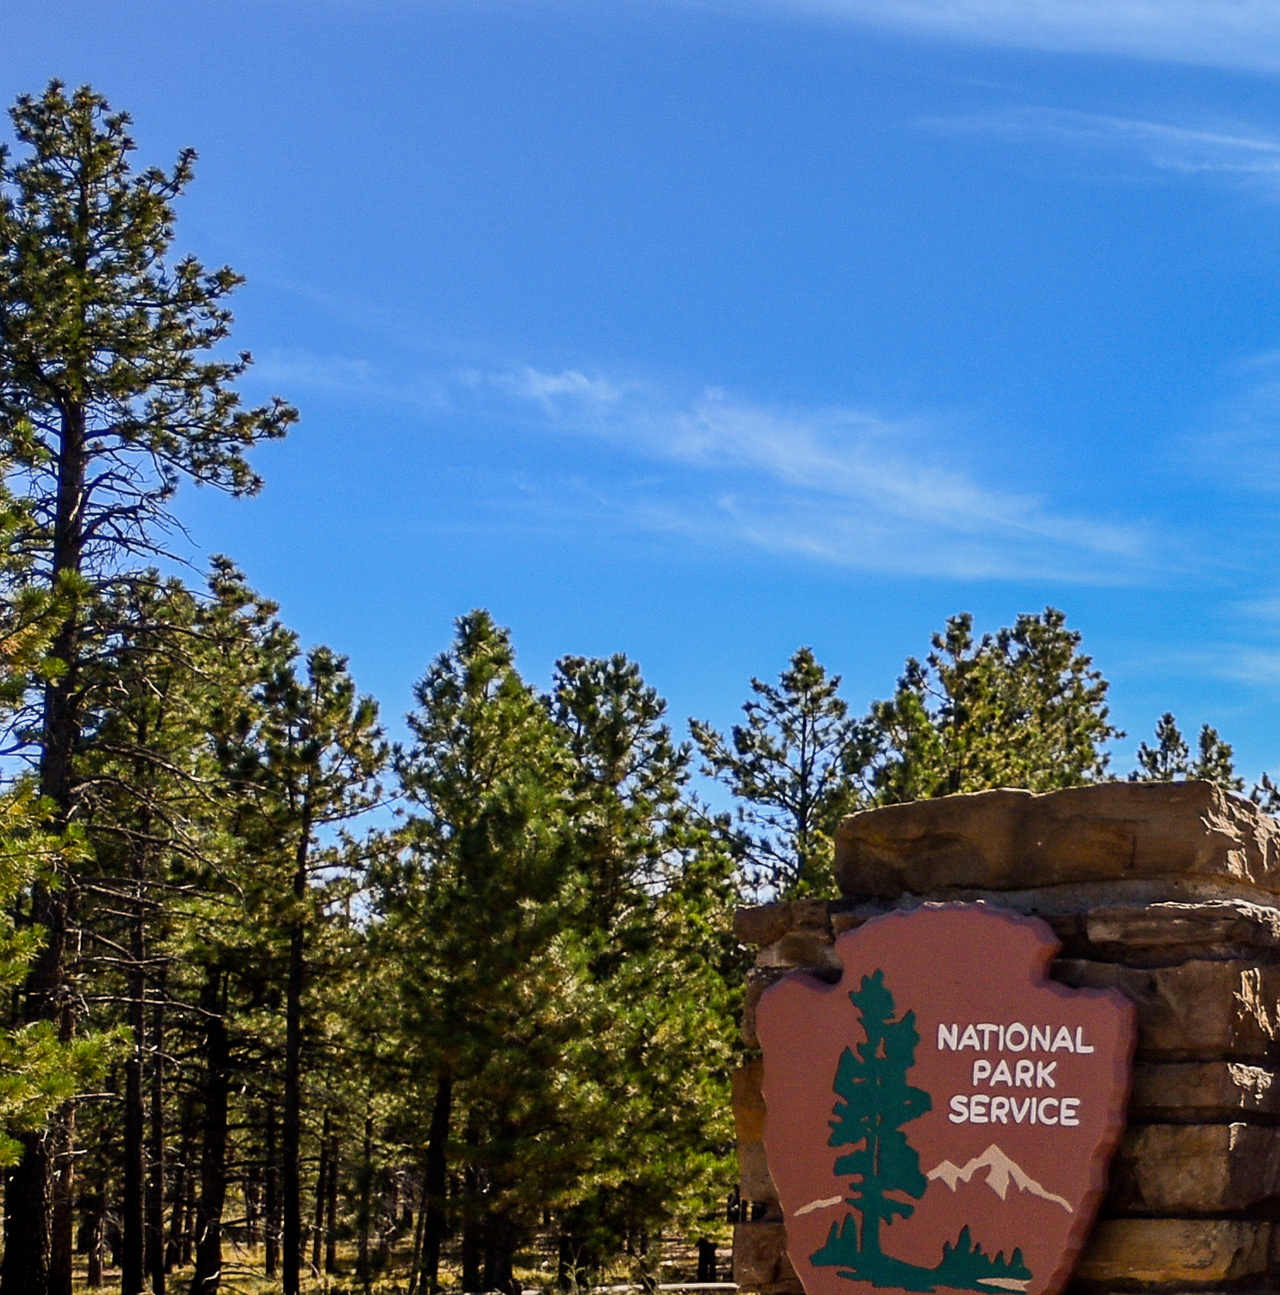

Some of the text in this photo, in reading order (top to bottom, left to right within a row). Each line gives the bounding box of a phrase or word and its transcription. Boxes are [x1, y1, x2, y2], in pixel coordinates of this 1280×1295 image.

[936, 1021, 1095, 1055] NATIONAL
[971, 1058, 1058, 1089] PARK
[947, 1093, 1081, 1127] SERVICE
